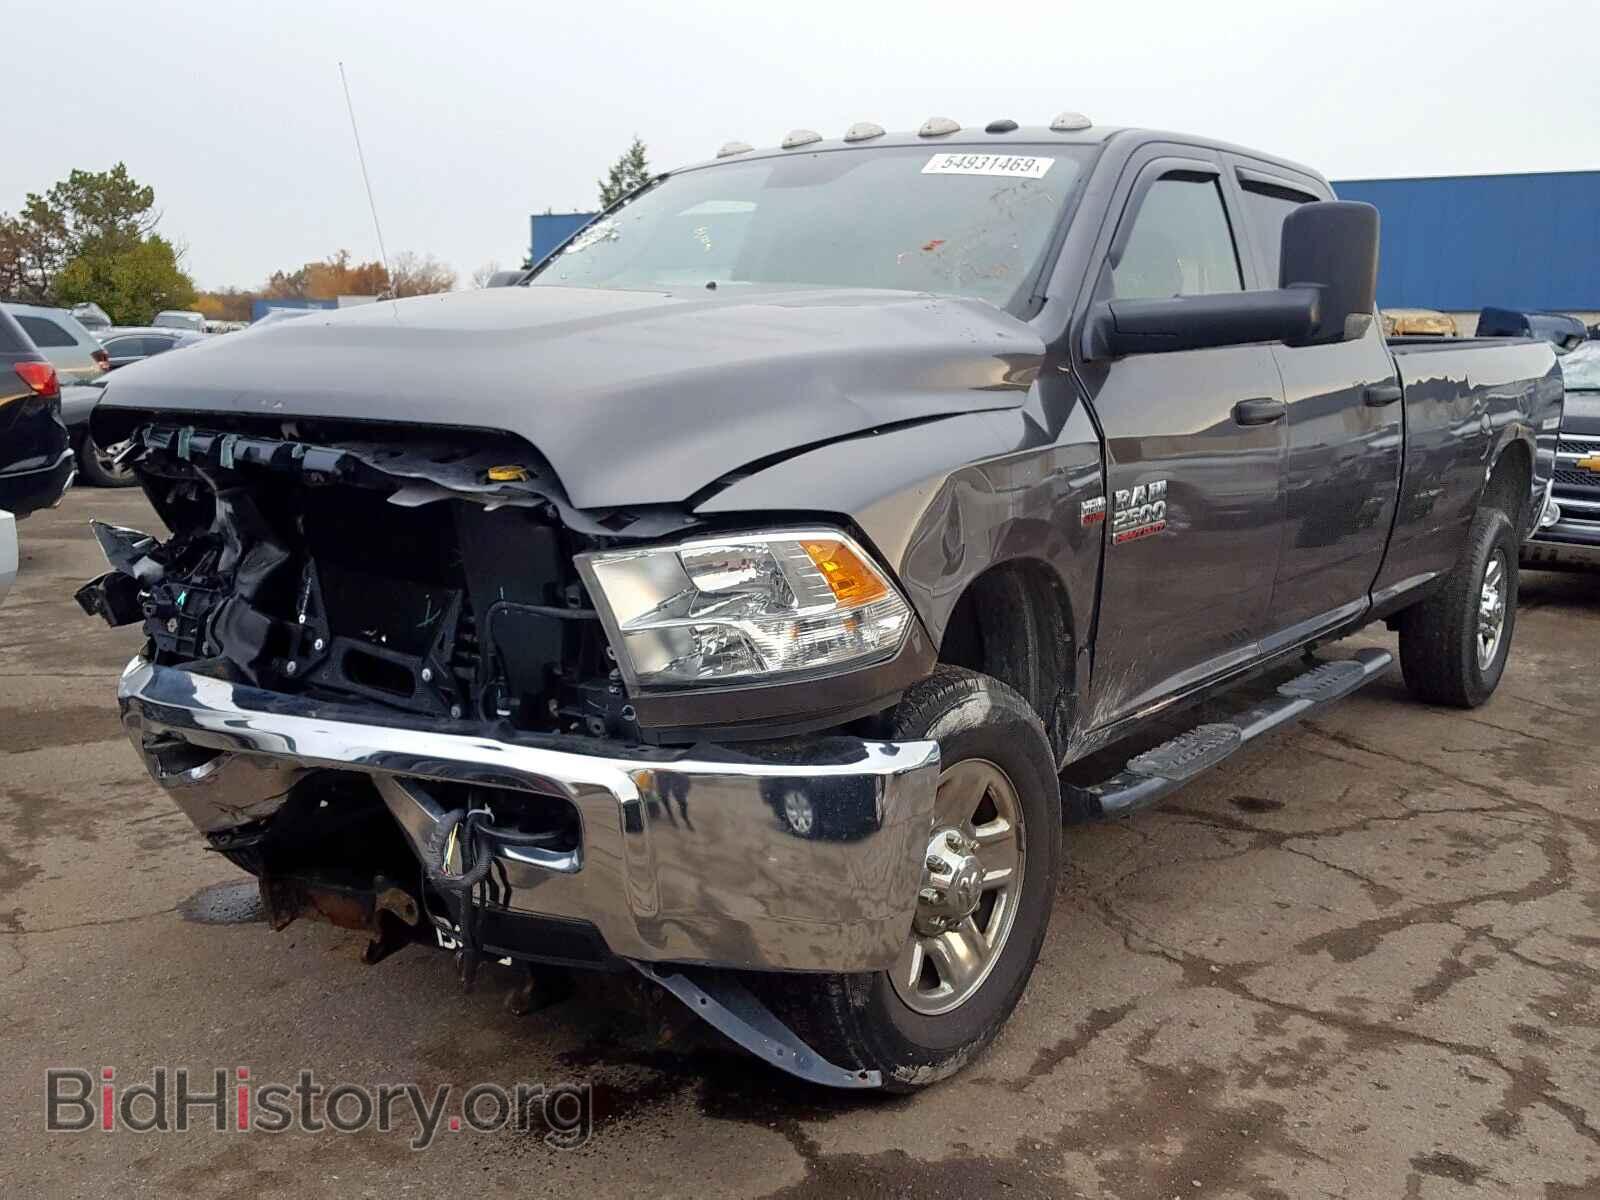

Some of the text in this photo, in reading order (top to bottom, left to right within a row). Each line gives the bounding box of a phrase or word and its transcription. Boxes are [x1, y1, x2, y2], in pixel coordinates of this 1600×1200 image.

[941, 156, 1036, 172] 54931469
[1114, 480, 1167, 510] RAM
[1113, 500, 1167, 530] 2500
